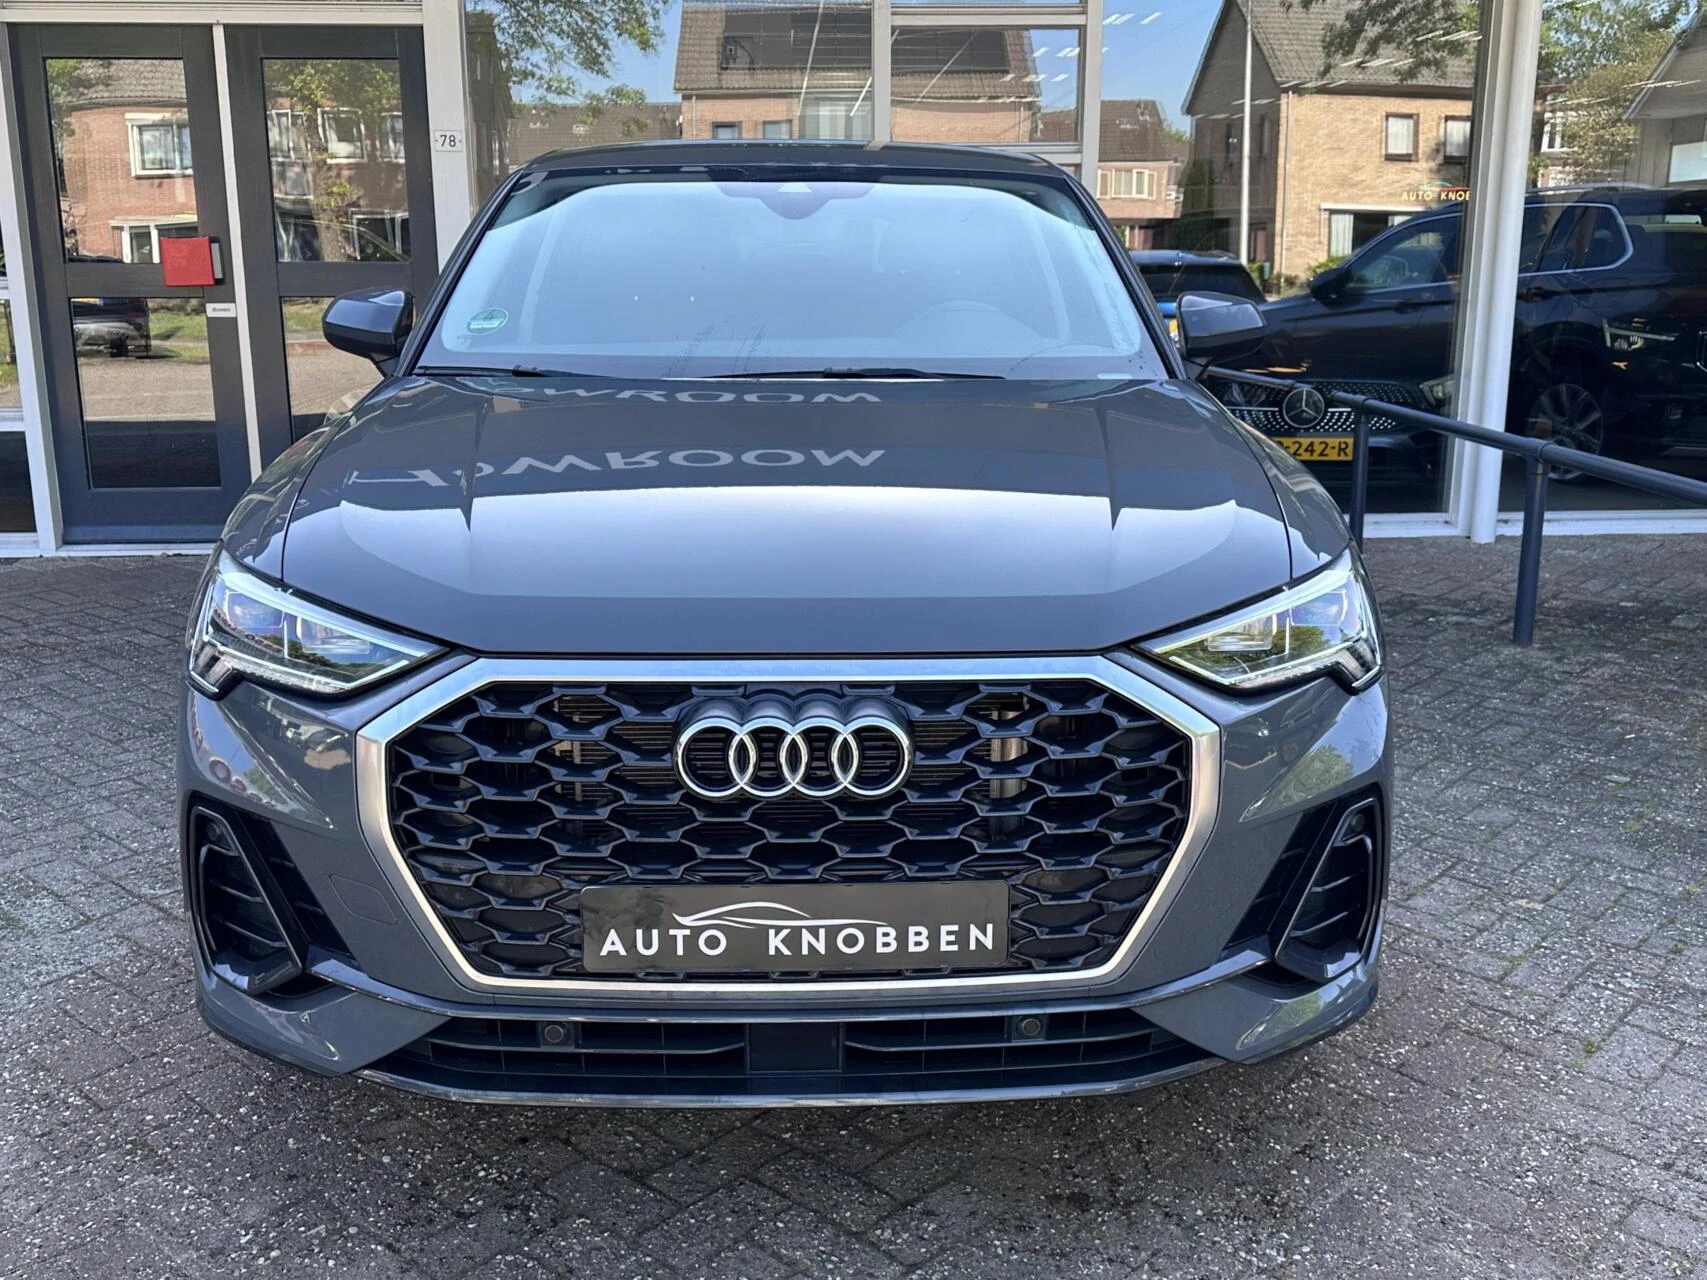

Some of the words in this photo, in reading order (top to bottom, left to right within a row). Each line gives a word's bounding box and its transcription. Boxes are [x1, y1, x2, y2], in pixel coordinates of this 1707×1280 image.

[439, 134, 456, 148] 78
[1400, 191, 1433, 201] AUTO
[599, 928, 727, 956] AUTO
[768, 923, 993, 956] KNOBBEN
